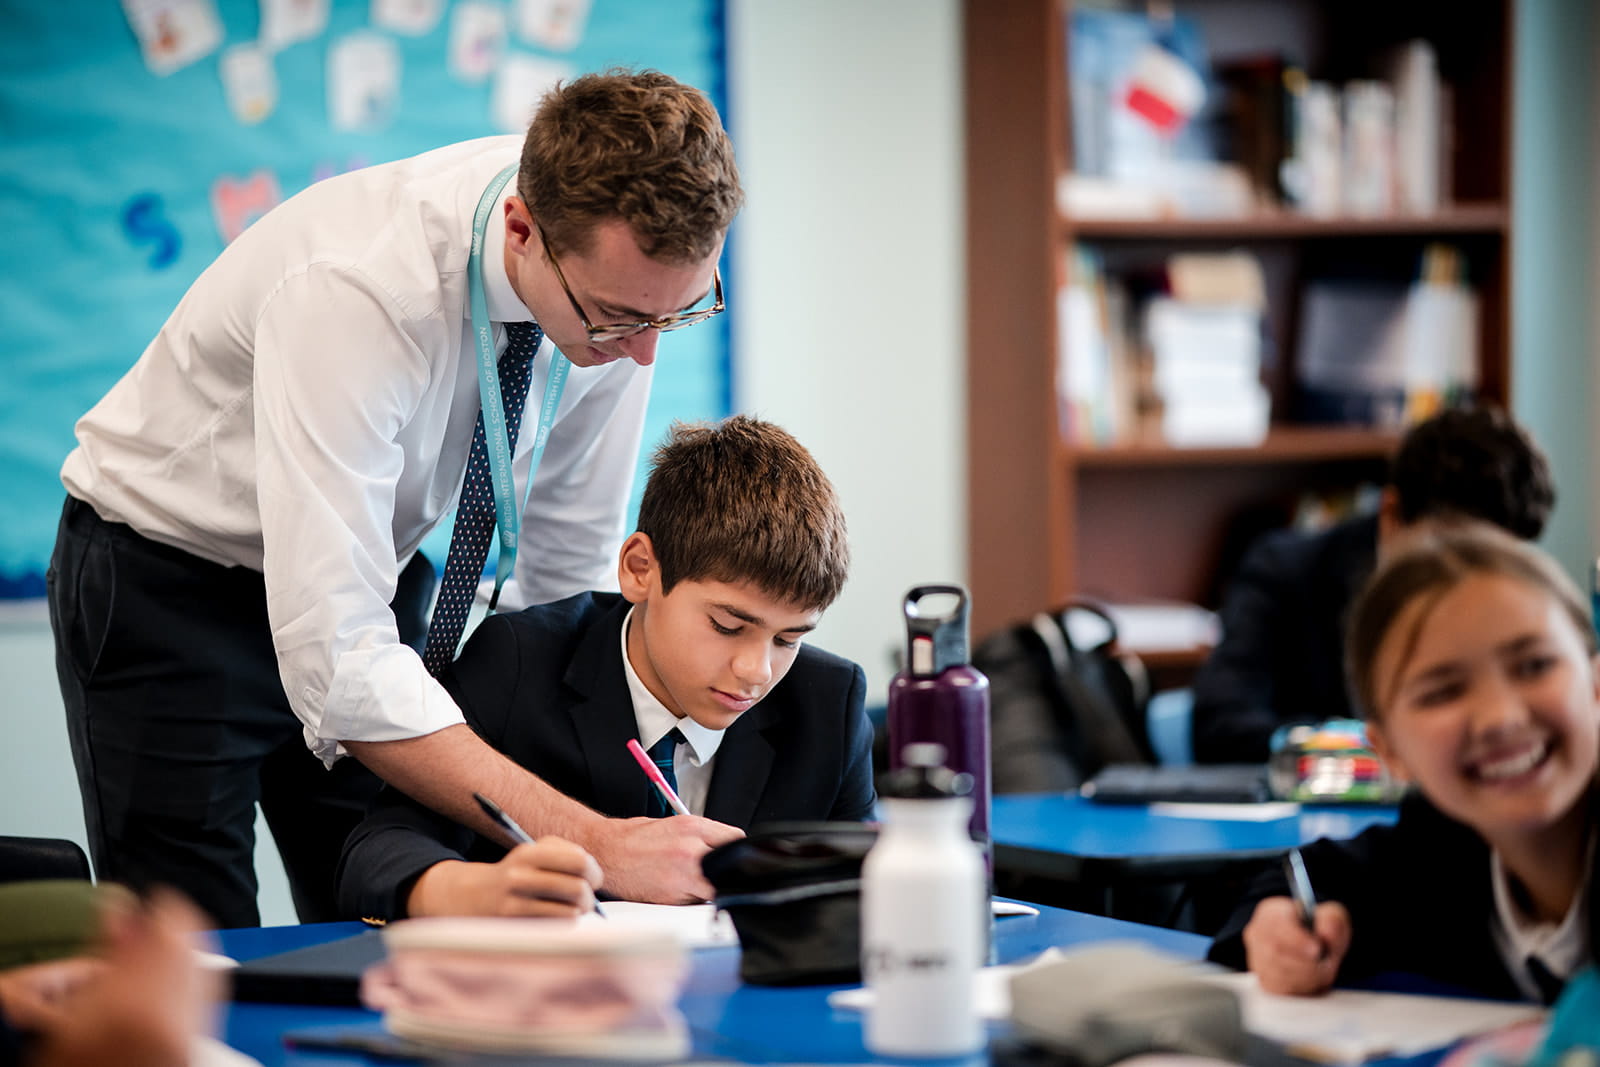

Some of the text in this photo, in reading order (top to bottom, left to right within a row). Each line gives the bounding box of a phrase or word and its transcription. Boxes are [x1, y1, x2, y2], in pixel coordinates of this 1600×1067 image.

[122, 191, 182, 269] S
[480, 326, 513, 528] BRITISH INTERNATIONAL SCHOOL OF BOSTON
[544, 385, 559, 422] BRITISH
